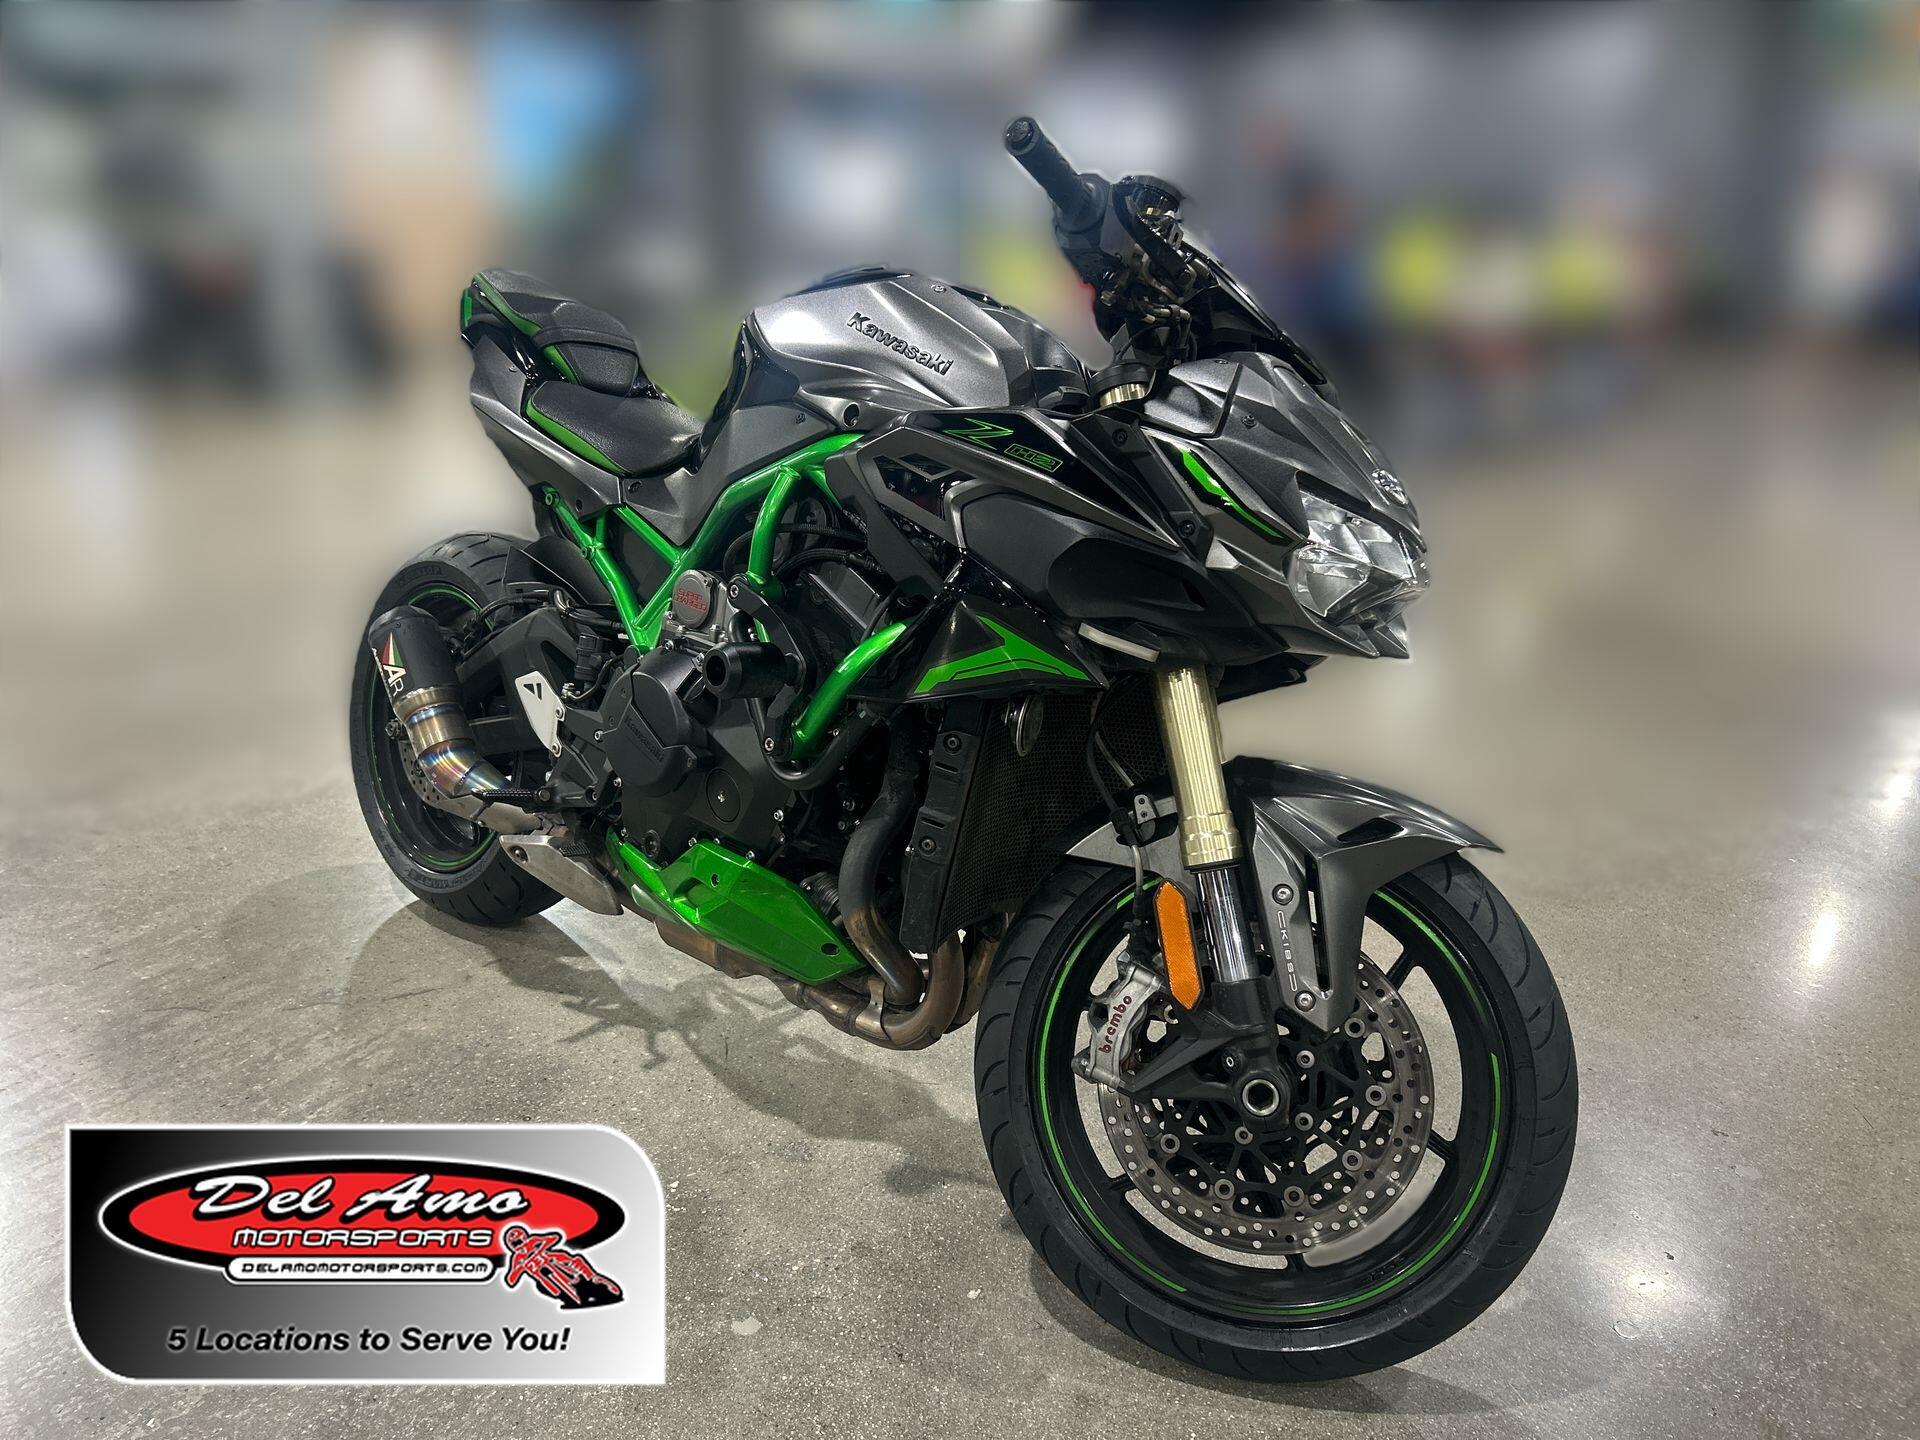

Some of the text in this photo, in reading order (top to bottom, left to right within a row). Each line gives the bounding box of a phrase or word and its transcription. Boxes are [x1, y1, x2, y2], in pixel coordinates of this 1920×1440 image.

[847, 312, 954, 376] Kawasaki
[942, 417, 1058, 470] Z H2
[382, 664, 407, 697] AR
[1098, 995, 1132, 1053] brembo
